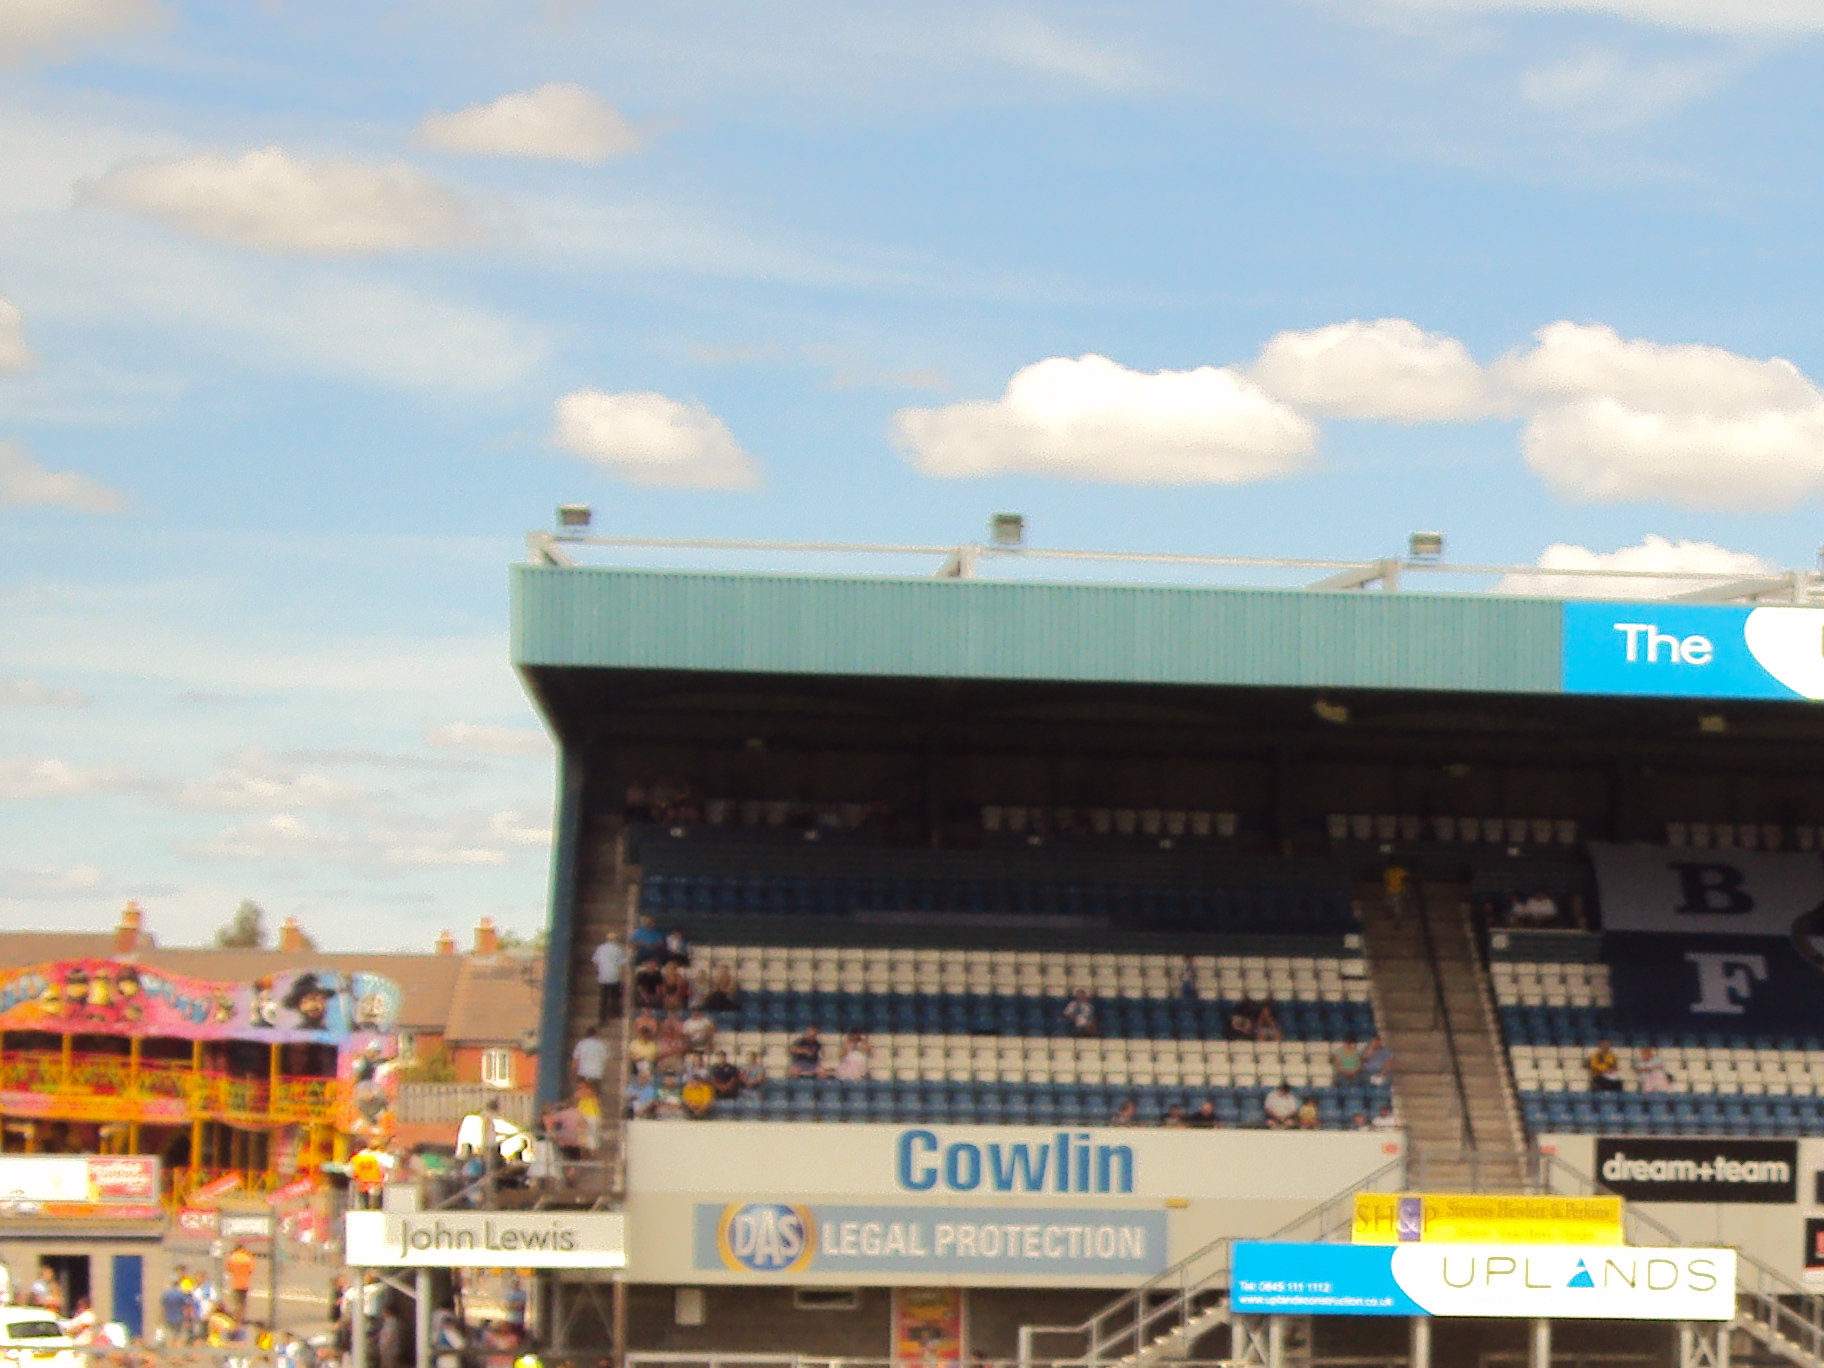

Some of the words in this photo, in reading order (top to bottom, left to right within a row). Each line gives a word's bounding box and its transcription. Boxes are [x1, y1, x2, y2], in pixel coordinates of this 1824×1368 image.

[1613, 623, 1713, 665] The
[1666, 861, 1755, 915] B
[1683, 951, 1768, 1015] F
[898, 1129, 1134, 1193] Cowlin
[1602, 1152, 1790, 1182] dream+team
[400, 1219, 475, 1258] John
[484, 1220, 575, 1251] Lewis
[735, 1209, 801, 1265] DAS
[822, 1221, 926, 1258] LEGAL
[934, 1222, 1146, 1261] PROTECTION
[1443, 1256, 1718, 1292] UPLANDS
